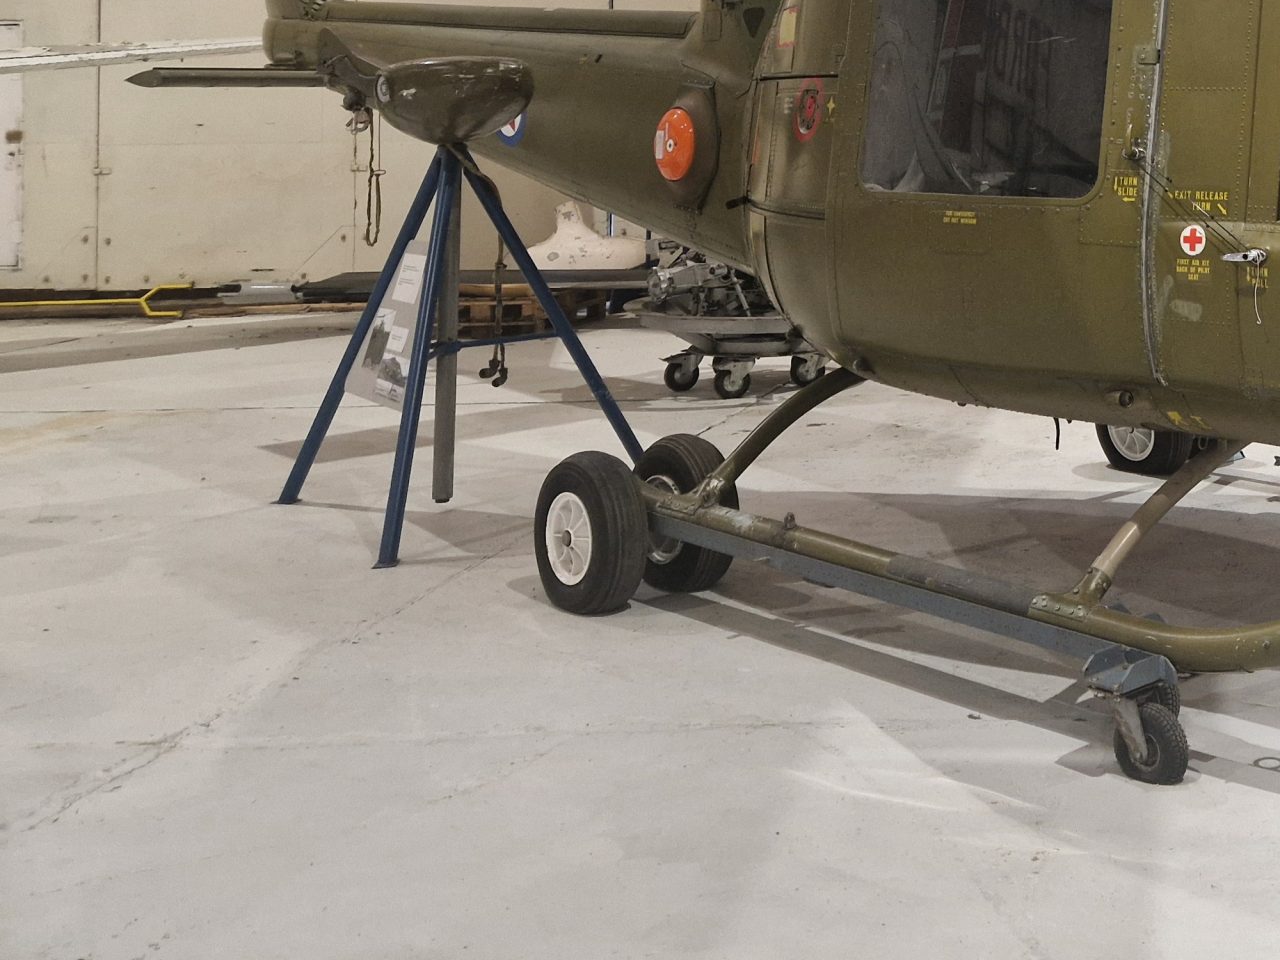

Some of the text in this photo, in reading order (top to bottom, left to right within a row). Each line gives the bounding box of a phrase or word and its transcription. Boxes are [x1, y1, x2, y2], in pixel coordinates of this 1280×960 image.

[1119, 176, 1138, 186] TURN
[1117, 187, 1138, 196] SLIDE
[1174, 190, 1229, 201] EXIT RELEASE
[1192, 202, 1211, 211] TURN
[1188, 273, 1199, 281] SEAT
